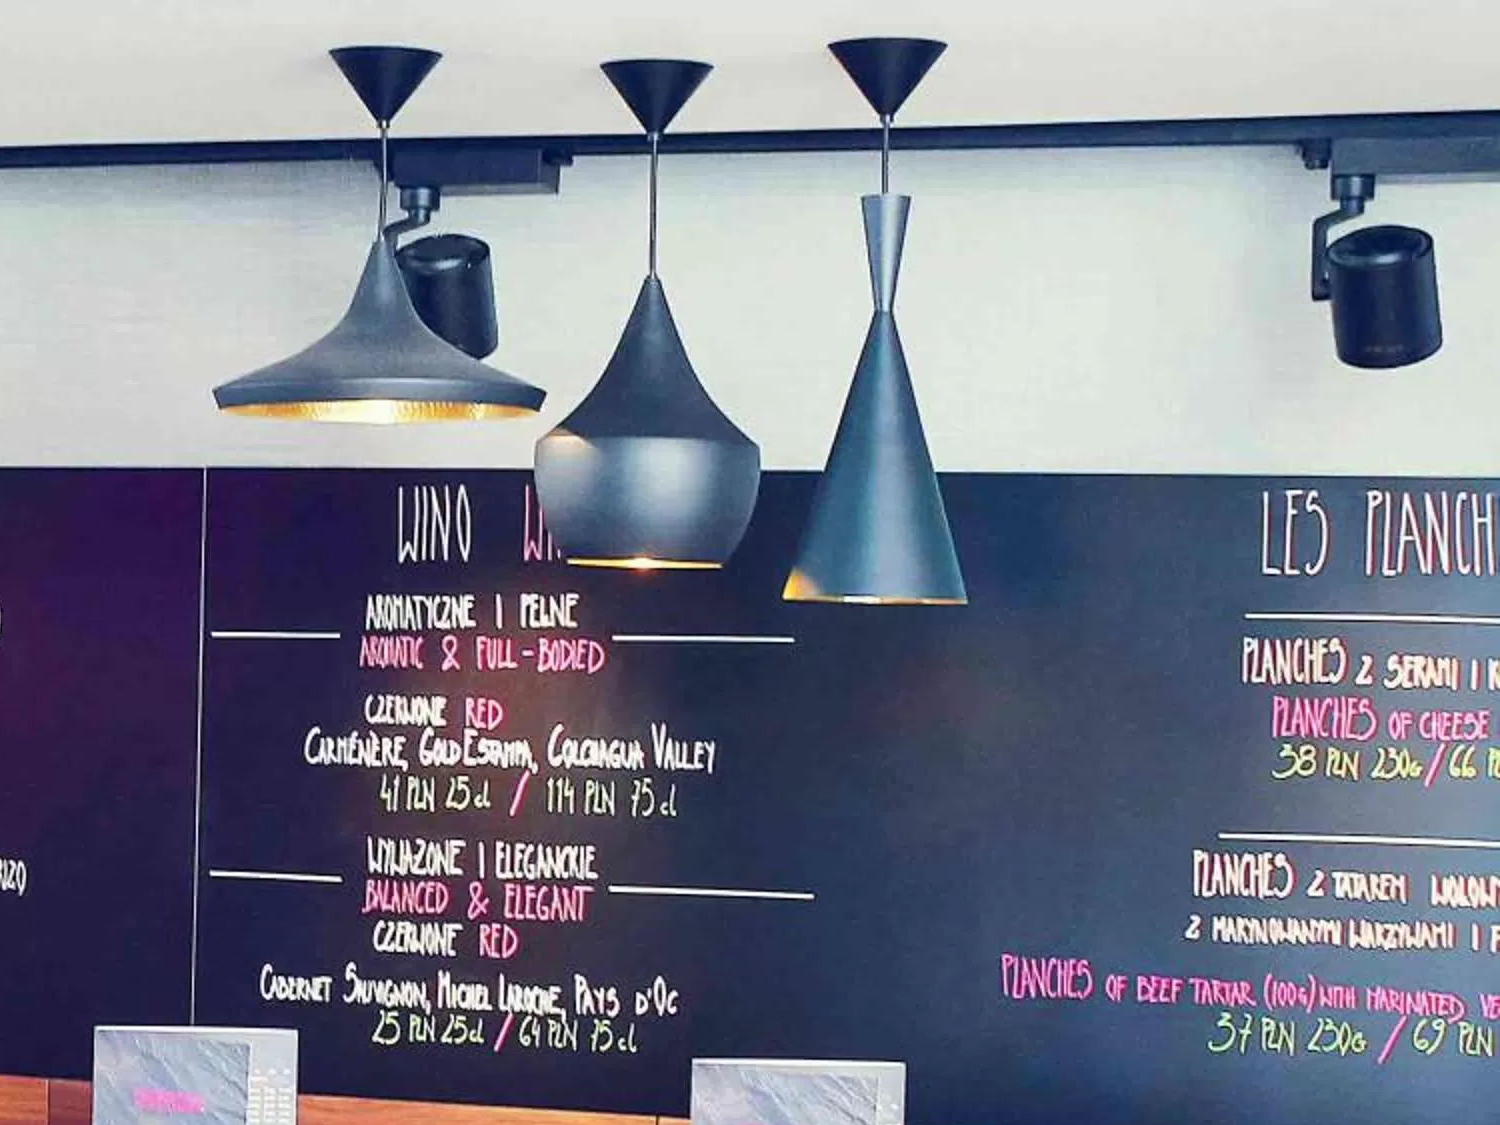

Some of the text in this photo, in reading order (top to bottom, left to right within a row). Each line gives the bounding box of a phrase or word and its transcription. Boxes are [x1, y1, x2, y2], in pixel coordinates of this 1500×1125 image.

[398, 485, 472, 565] WINO
[1261, 489, 1329, 576] LES
[366, 593, 477, 632] AROMATYCZNE
[360, 635, 425, 670] AROMATIC
[442, 635, 461, 671] &
[1242, 636, 1348, 685] PLANCHES
[1383, 652, 1459, 691] SERAMI
[365, 693, 505, 731] CZERWONE RED
[1271, 696, 1492, 742] PLANCHES OF CHEESE
[651, 723, 716, 774] VALLEY
[1271, 744, 1317, 780] 38
[1325, 747, 1360, 782] PLN
[379, 776, 401, 812] 41
[407, 776, 435, 812] PLN
[547, 778, 575, 814] 114
[585, 778, 615, 816] PLN
[495, 840, 599, 881] ELEGANCKIE
[1192, 849, 1296, 900] PLANCHES
[1332, 870, 1409, 904] TATAREM
[361, 880, 595, 922] BALANCED & ELEGANT
[373, 919, 519, 959] CZERWONE RED
[1349, 920, 1456, 951] WARZYWAMI
[259, 963, 333, 1003] CABERNET
[436, 969, 493, 1013] MICHEL
[574, 975, 621, 1018] PAYS
[1000, 953, 1094, 999] PLANCHES
[1104, 972, 1129, 1001] OF
[1135, 975, 1185, 1003] BEEF
[1188, 976, 1257, 1008] TARTAR
[1319, 984, 1357, 1010] WITH
[1366, 986, 1467, 1025] MARINATED
[372, 1011, 401, 1046] 25
[409, 1013, 436, 1045] PLN
[519, 1014, 544, 1048] 64
[547, 1014, 577, 1051] PLN
[1207, 1012, 1494, 1057] 37 PLN 69 PLN
